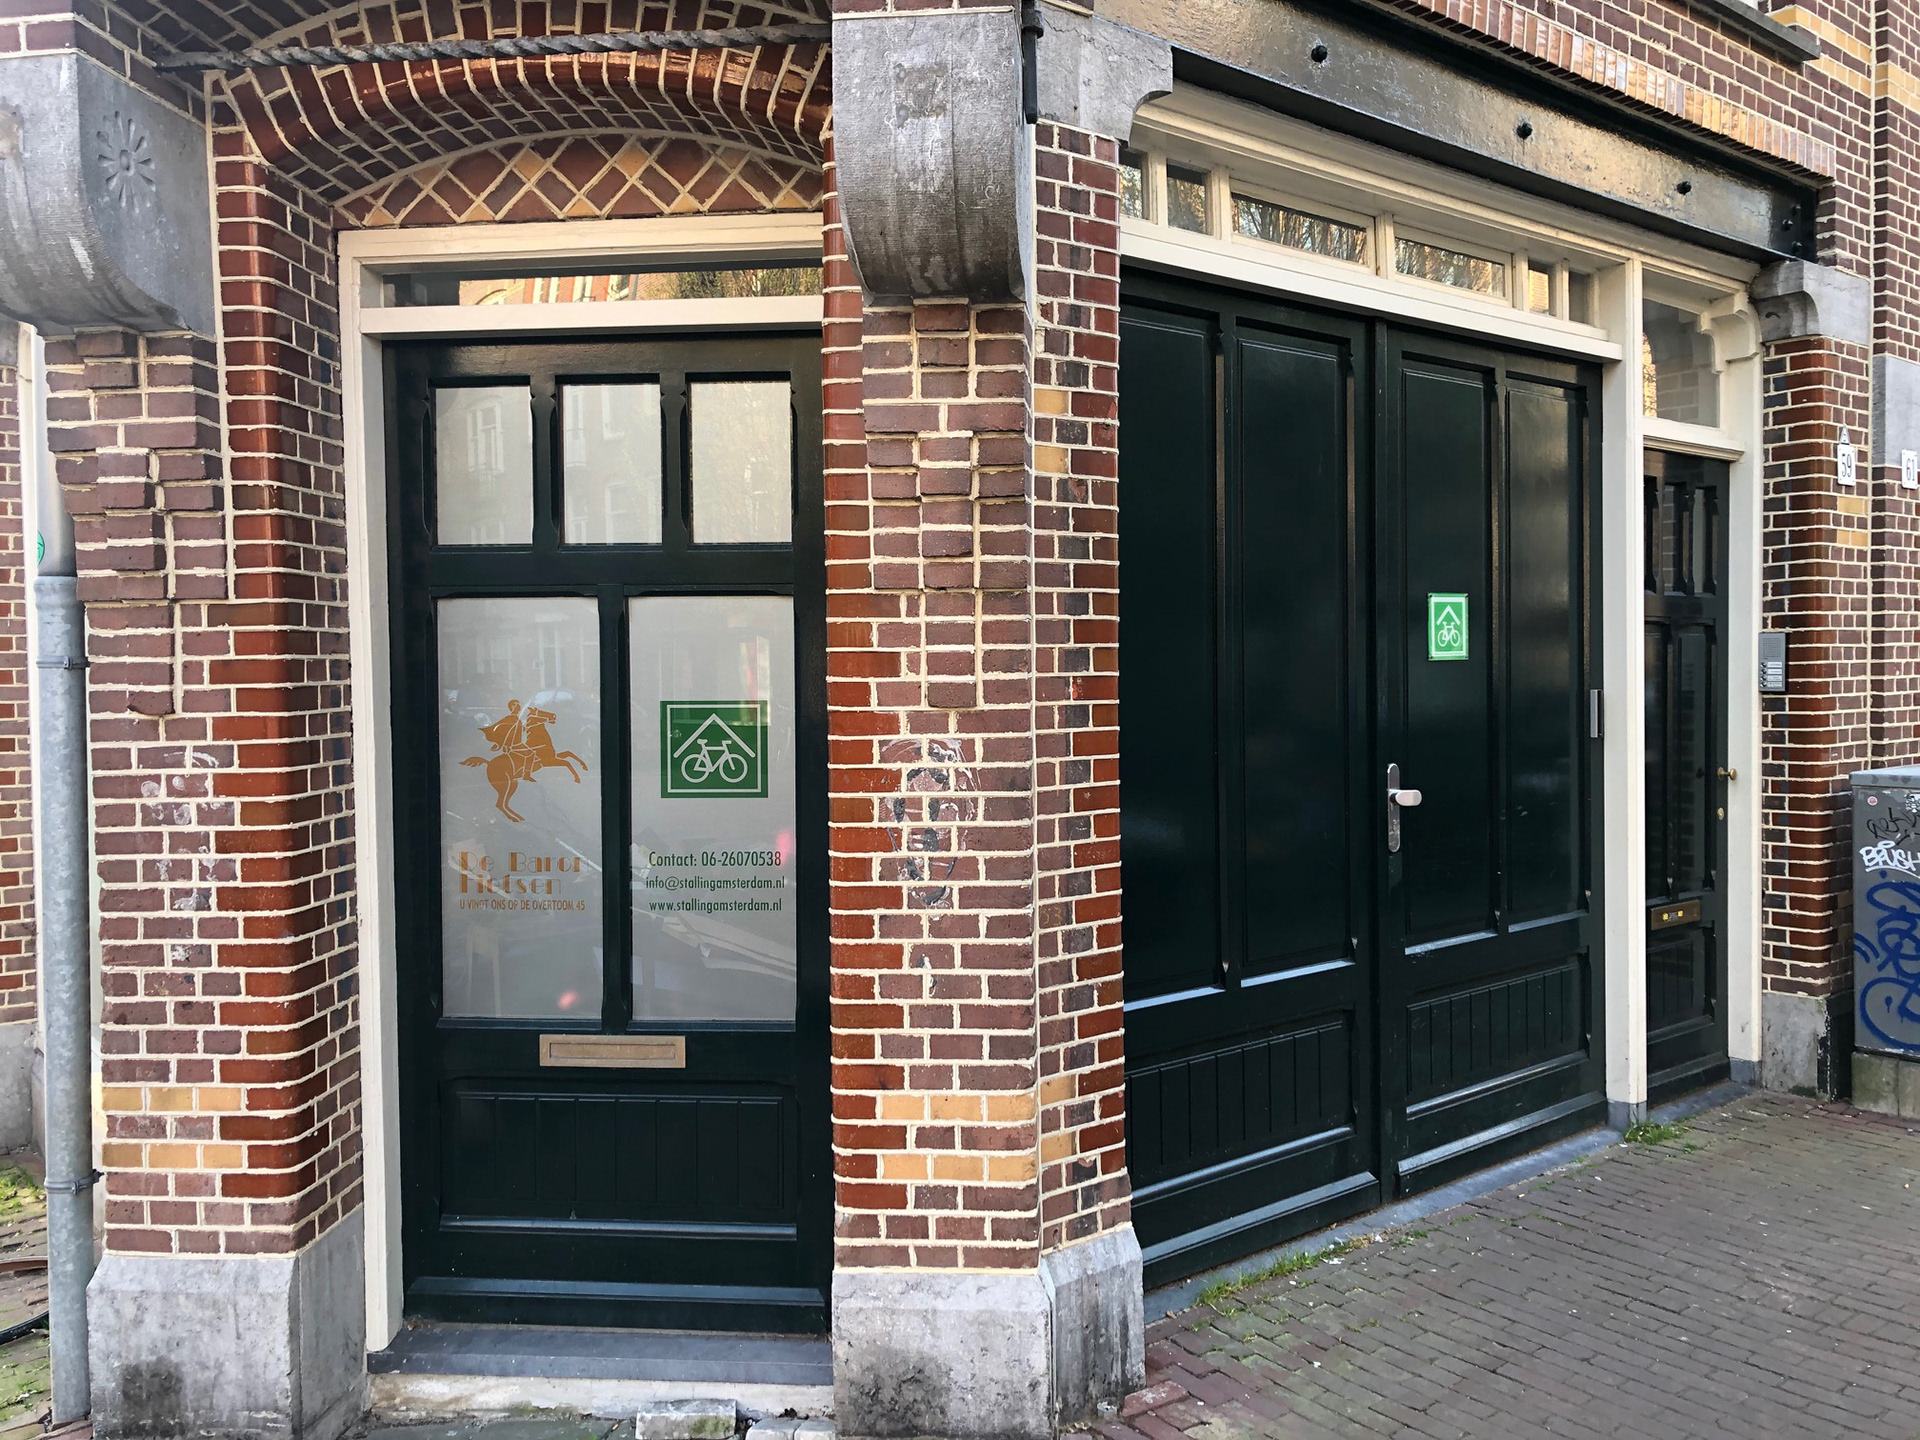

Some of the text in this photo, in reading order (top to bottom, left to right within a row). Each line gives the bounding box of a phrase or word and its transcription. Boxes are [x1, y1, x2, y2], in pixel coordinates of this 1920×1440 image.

[1841, 453, 1852, 478] 59
[1906, 458, 1915, 482] 61
[459, 851, 495, 872] De
[648, 851, 782, 867] Contact: 06-26070538
[645, 875, 785, 892] info@stallingamsterdam.nl
[459, 899, 465, 910] U
[491, 899, 506, 910] ONS
[508, 899, 518, 910] OP
[520, 899, 530, 910] DE
[576, 900, 585, 911] 45
[648, 897, 782, 914] www.stallingamsterdam.nl
